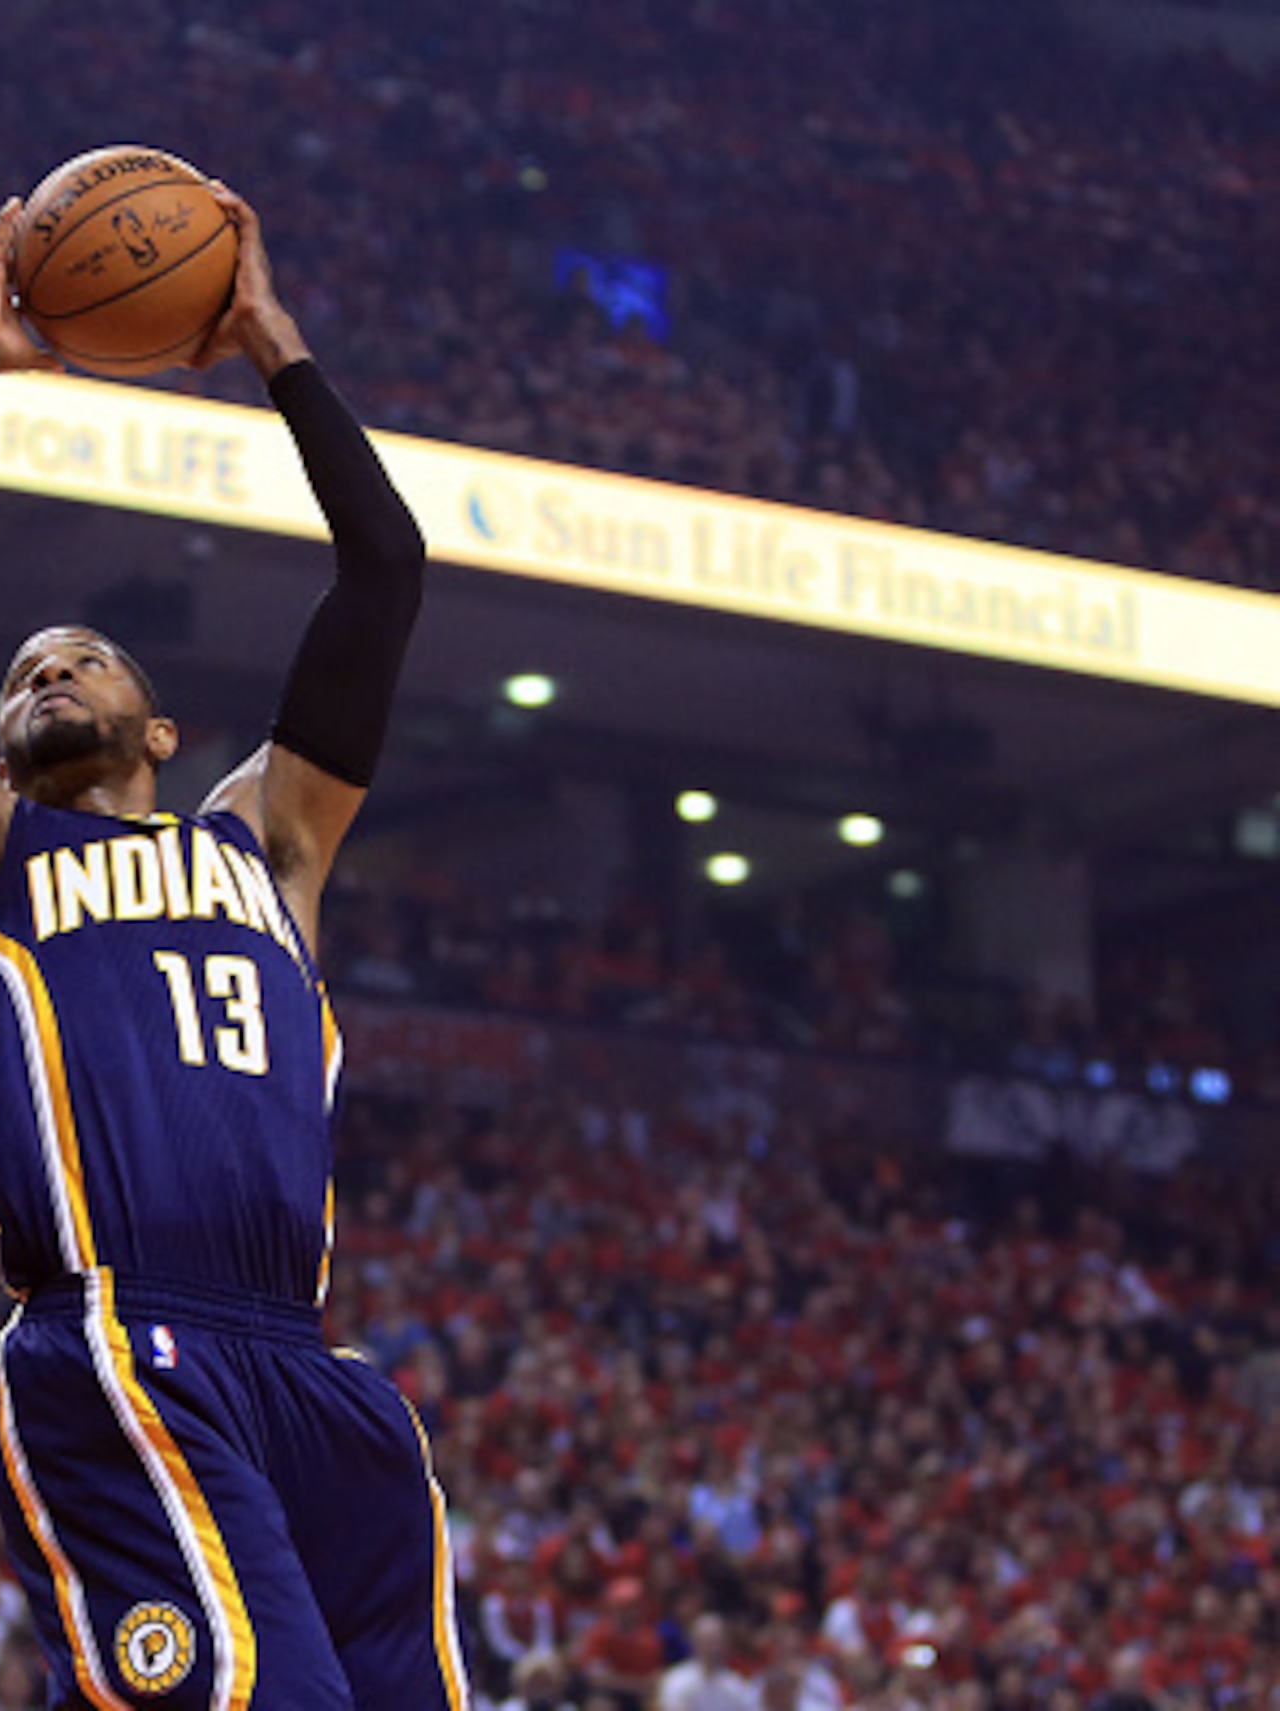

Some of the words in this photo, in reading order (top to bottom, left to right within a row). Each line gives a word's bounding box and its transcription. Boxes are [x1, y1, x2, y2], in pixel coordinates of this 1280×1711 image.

[1, 411, 105, 477] FOR
[120, 420, 248, 503] LIFE
[533, 489, 672, 574] Sun
[690, 512, 820, 601] Life
[837, 539, 1139, 658] Financial
[25, 826, 308, 982] INDIAN
[152, 950, 269, 1075] 13
